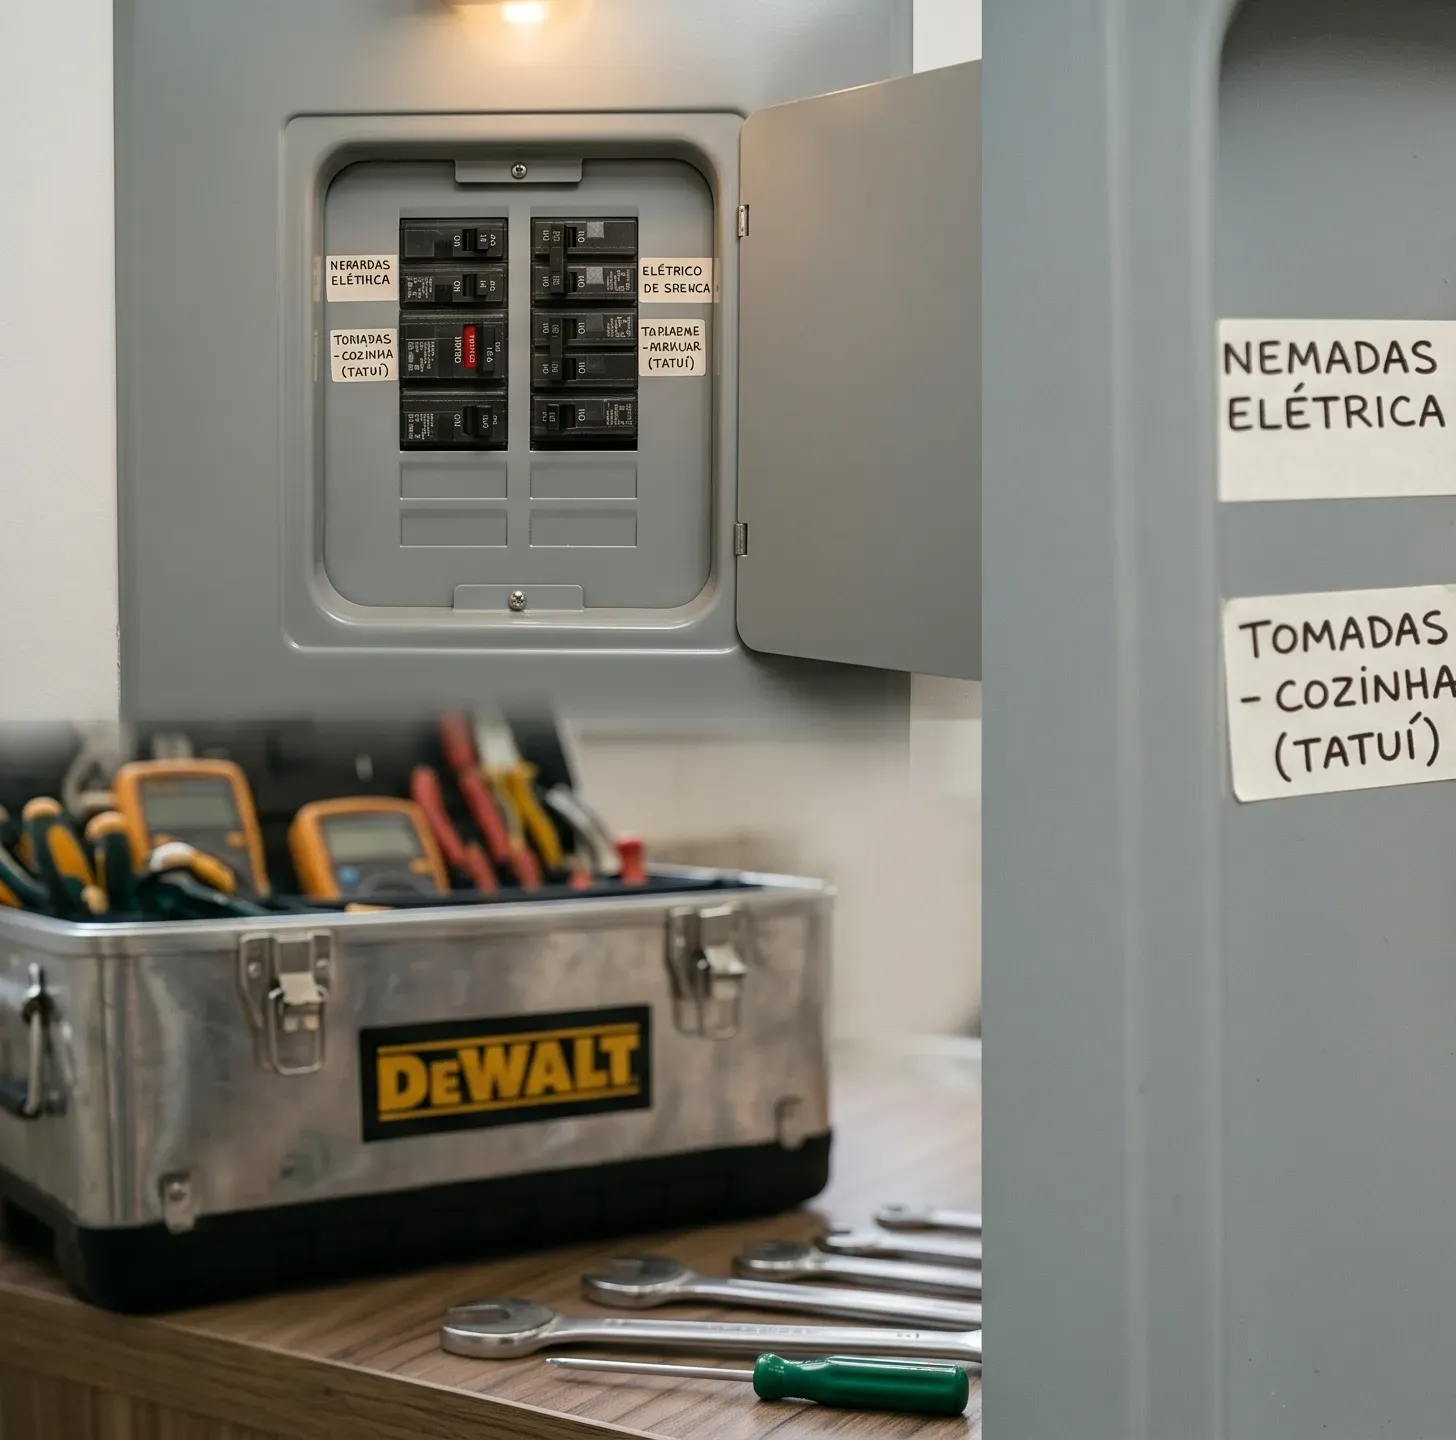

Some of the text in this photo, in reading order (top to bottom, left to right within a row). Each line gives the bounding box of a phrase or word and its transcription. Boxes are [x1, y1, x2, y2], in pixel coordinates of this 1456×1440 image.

[642, 264, 703, 276] ELÉTRICO
[644, 283, 659, 293] DE
[1223, 339, 1438, 375] NEMADAS
[1228, 381, 1446, 431] ELÉTRICA
[1238, 609, 1449, 659] TOMADAS
[1274, 711, 1440, 783] (TATUÍ)
